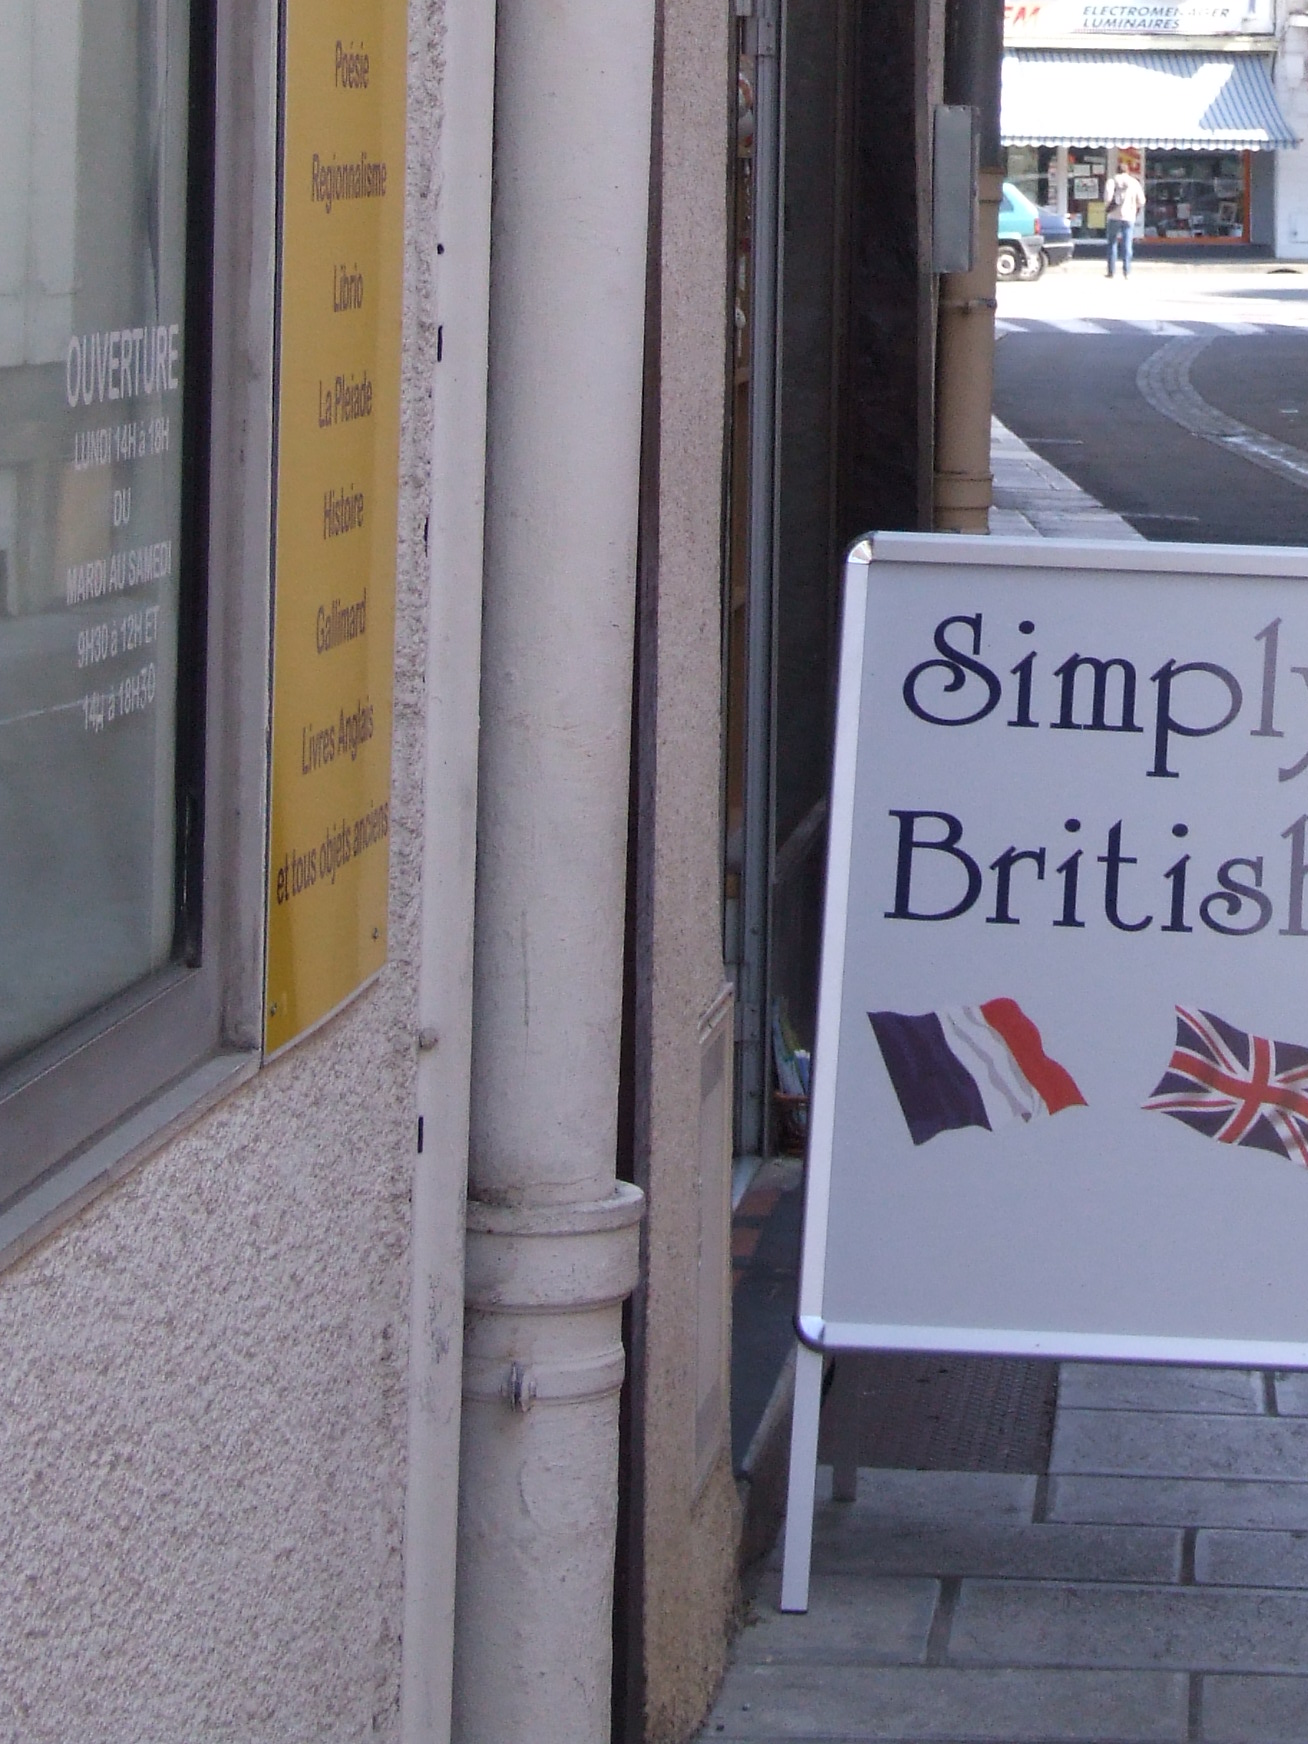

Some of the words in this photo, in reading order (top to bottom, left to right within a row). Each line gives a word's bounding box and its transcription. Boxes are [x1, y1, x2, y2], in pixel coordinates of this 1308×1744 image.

[1083, 19, 1181, 30] LUMINAIRES
[335, 40, 370, 90] Poésie
[333, 263, 364, 314] Librio
[66, 324, 179, 408] OUVERTURE
[319, 380, 332, 428] La
[75, 427, 112, 471] LUNDI
[115, 422, 137, 462] 14H
[148, 417, 170, 455] 18H
[113, 487, 131, 526] DU
[323, 483, 364, 541] Histoire
[66, 559, 107, 606] MARDI
[109, 552, 126, 593] AU
[128, 540, 172, 586] SAMEDI
[77, 623, 108, 668] 9H30
[120, 610, 142, 652] 12H
[145, 605, 160, 644] ET
[316, 588, 367, 655] Gallimard
[119, 662, 156, 716] 18H30
[302, 723, 335, 776] Livres
[337, 695, 374, 762] Anglais
[276, 852, 289, 906] et
[292, 847, 316, 895] tous
[319, 818, 351, 885] objets
[352, 799, 390, 857] anciens
